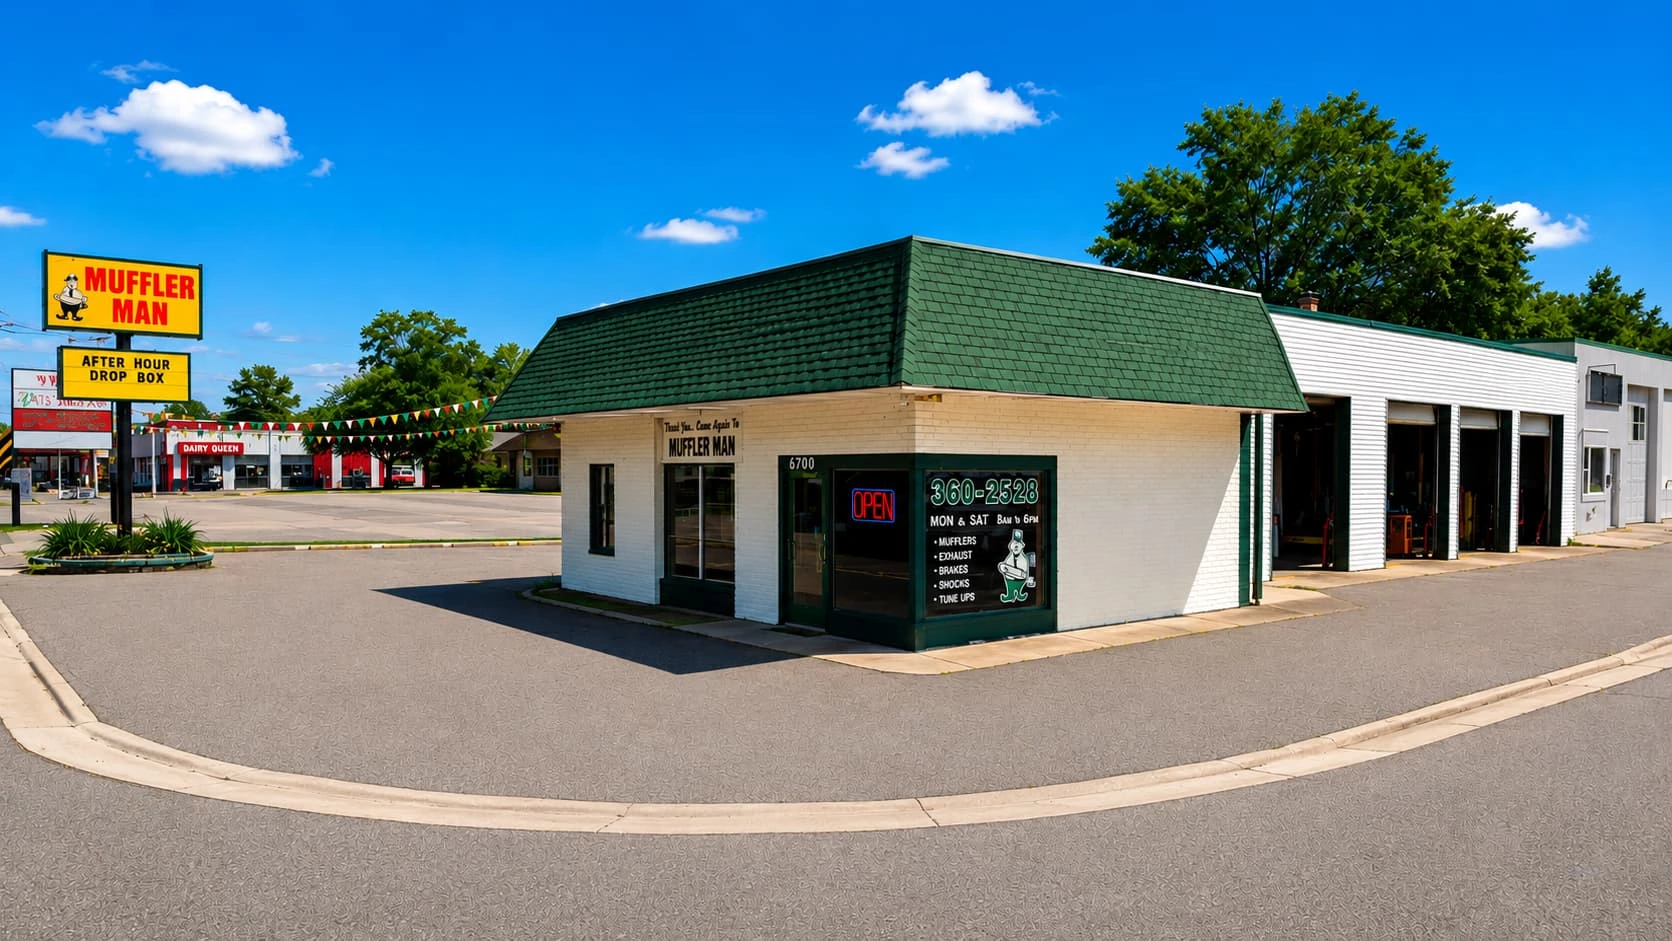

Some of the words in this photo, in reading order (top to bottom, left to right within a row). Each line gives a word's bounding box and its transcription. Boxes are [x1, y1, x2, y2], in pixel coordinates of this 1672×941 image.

[85, 266, 195, 300] MUFFLER
[112, 298, 168, 326] MAN
[82, 355, 125, 369] AFTER
[134, 358, 170, 370] HOUR
[90, 370, 127, 382] DROP
[138, 372, 164, 384] BOX
[696, 420, 711, 431] Come
[713, 419, 730, 433] Again
[732, 417, 739, 429] To
[183, 444, 208, 453] DAIRY
[212, 444, 239, 453] QUEEN
[669, 436, 710, 457] MUFFLER
[713, 435, 736, 456] MAN
[789, 457, 815, 470] 6700
[930, 478, 1039, 506] 360-2528
[853, 491, 894, 521] OPEN
[930, 515, 954, 527] MON
[958, 517, 966, 527] &
[969, 514, 989, 526] SAT
[938, 536, 977, 547] MUFFLERS
[939, 550, 973, 562] EXHAUST
[938, 564, 969, 575] BRAKES
[938, 579, 970, 590] SHOCKS
[938, 593, 959, 604] TUNE
[960, 592, 975, 603] UPS
